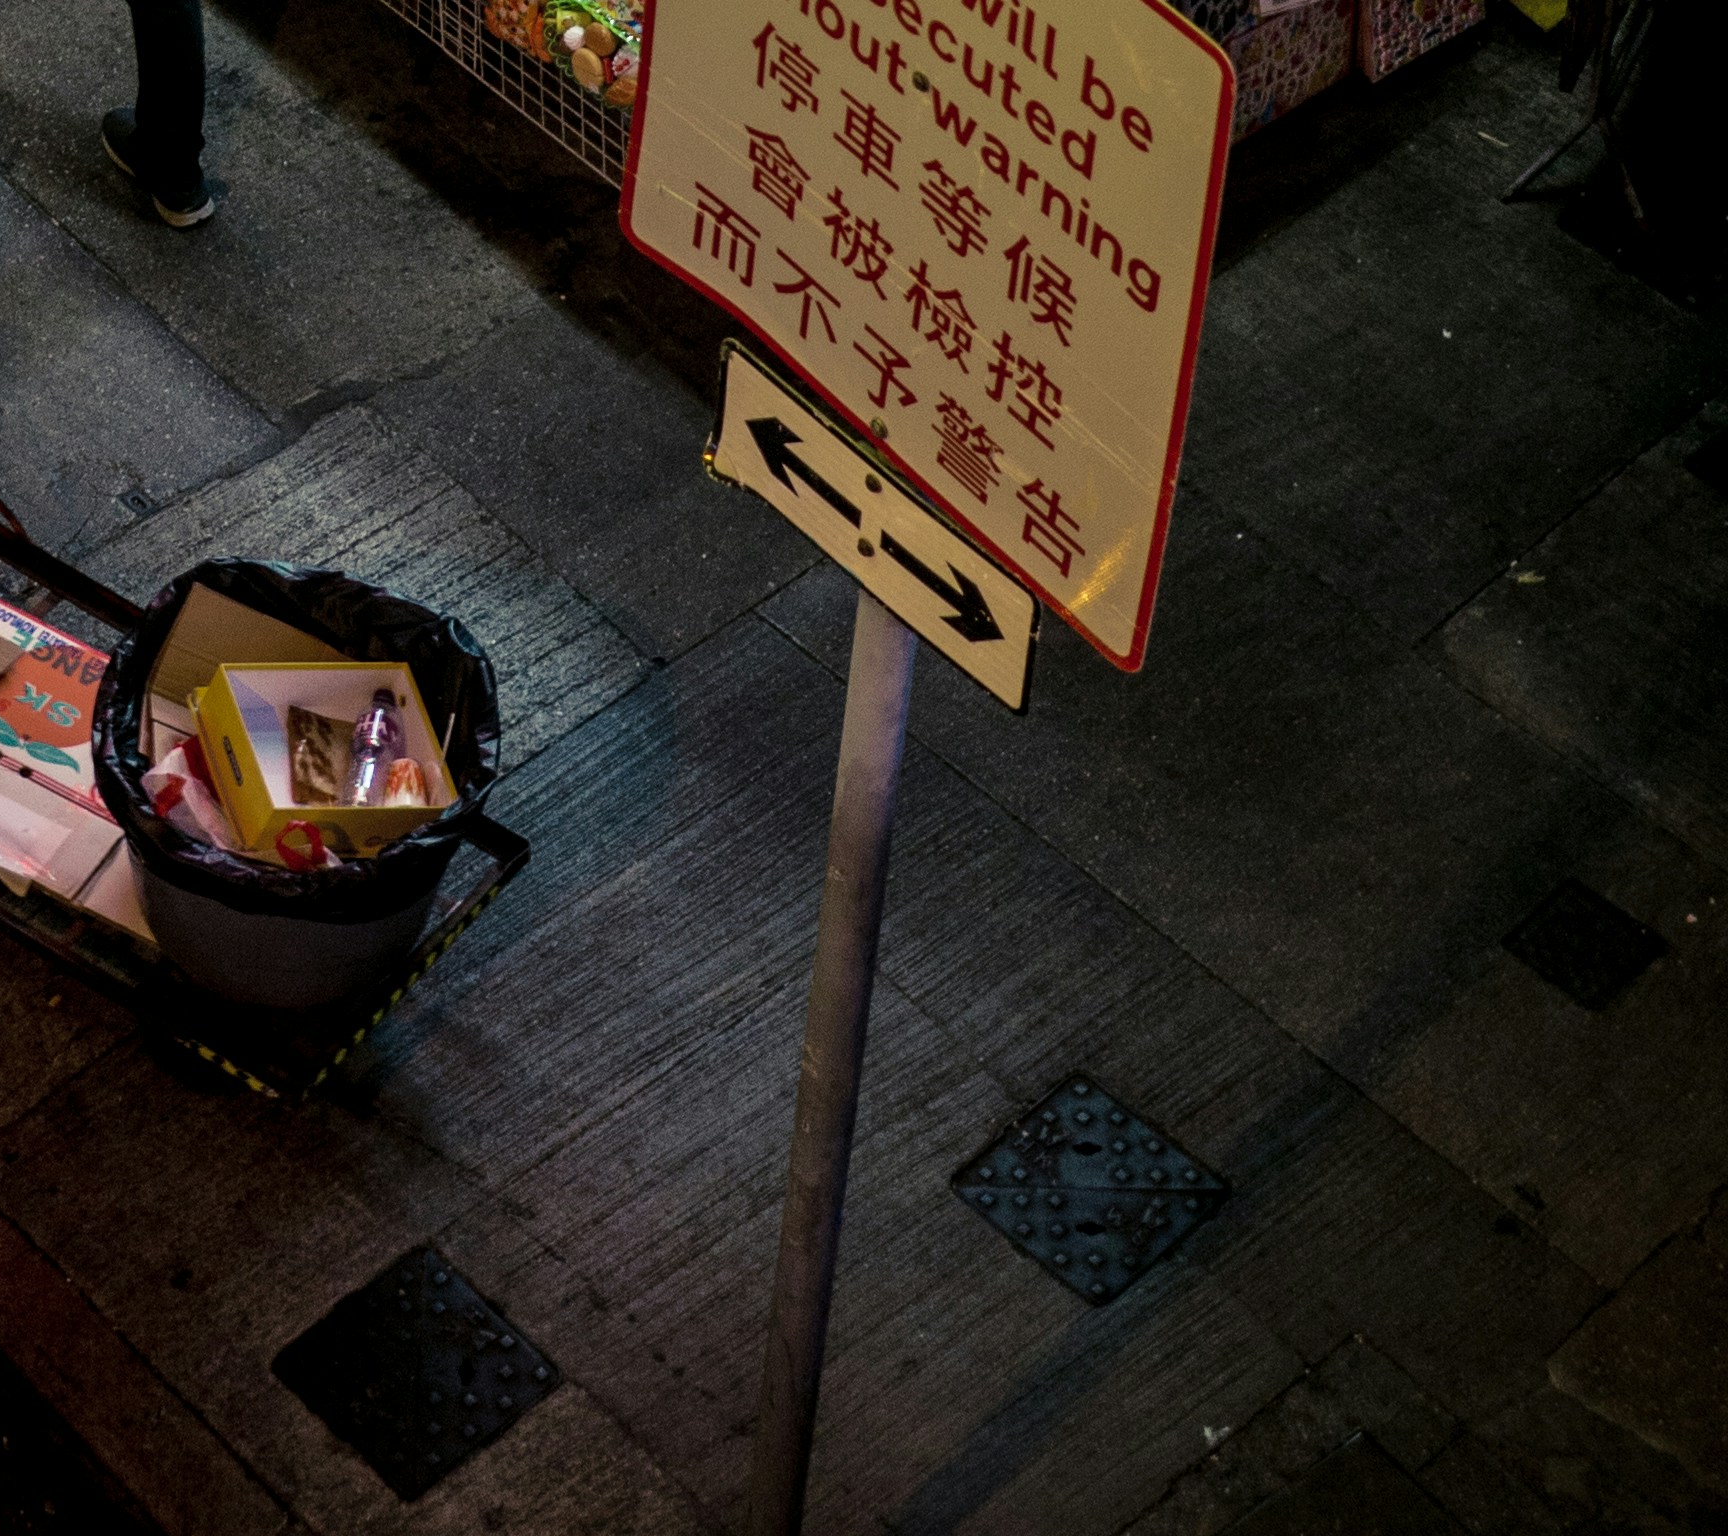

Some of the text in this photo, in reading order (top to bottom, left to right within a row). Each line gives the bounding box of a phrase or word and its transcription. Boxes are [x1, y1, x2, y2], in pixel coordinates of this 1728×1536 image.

[751, 21, 1079, 347] 停車等候
[932, 81, 1163, 313] warning
[1082, 54, 1155, 154] be
[691, 180, 1086, 579] 而不予警告
[744, 123, 1064, 451] 會被檢控
[15, 682, 81, 727] SK
